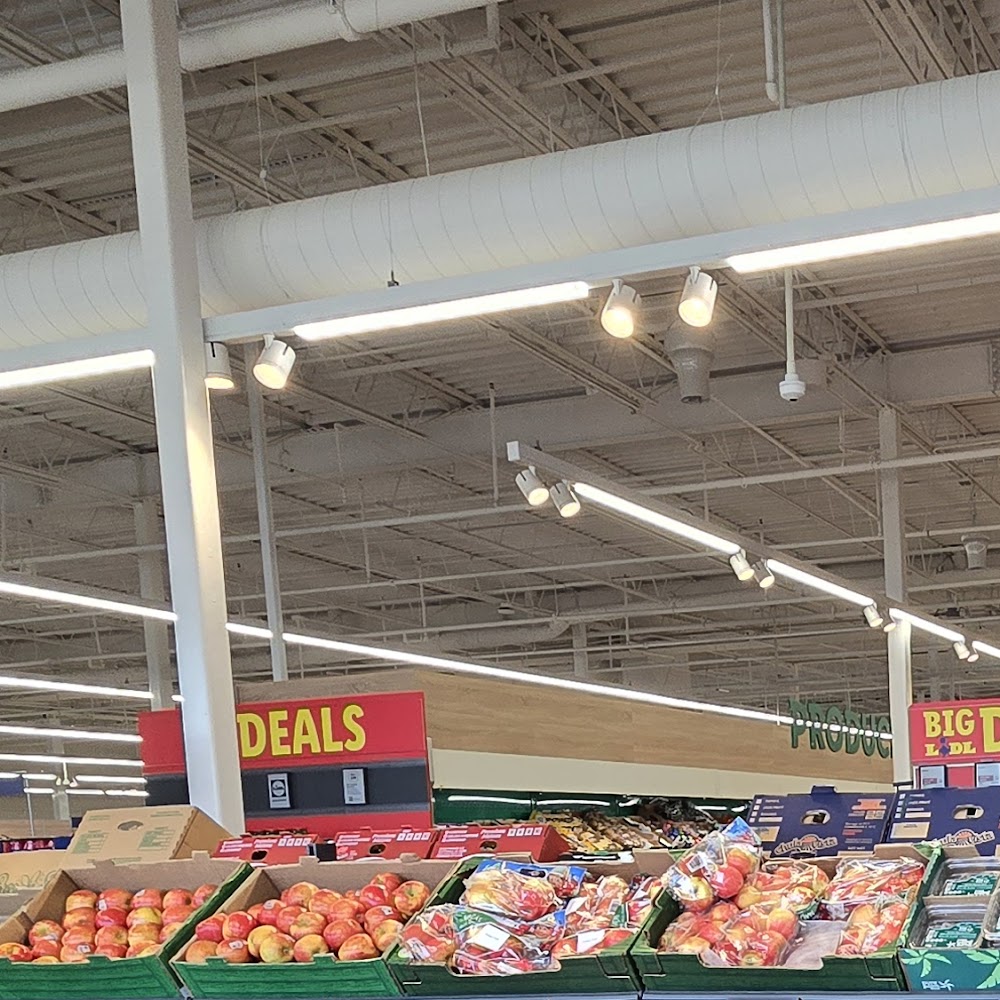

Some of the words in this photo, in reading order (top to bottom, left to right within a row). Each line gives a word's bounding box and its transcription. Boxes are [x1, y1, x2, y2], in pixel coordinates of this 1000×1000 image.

[236, 704, 367, 758] DEALS
[788, 697, 893, 759] PRODUC
[923, 708, 975, 738] BIG
